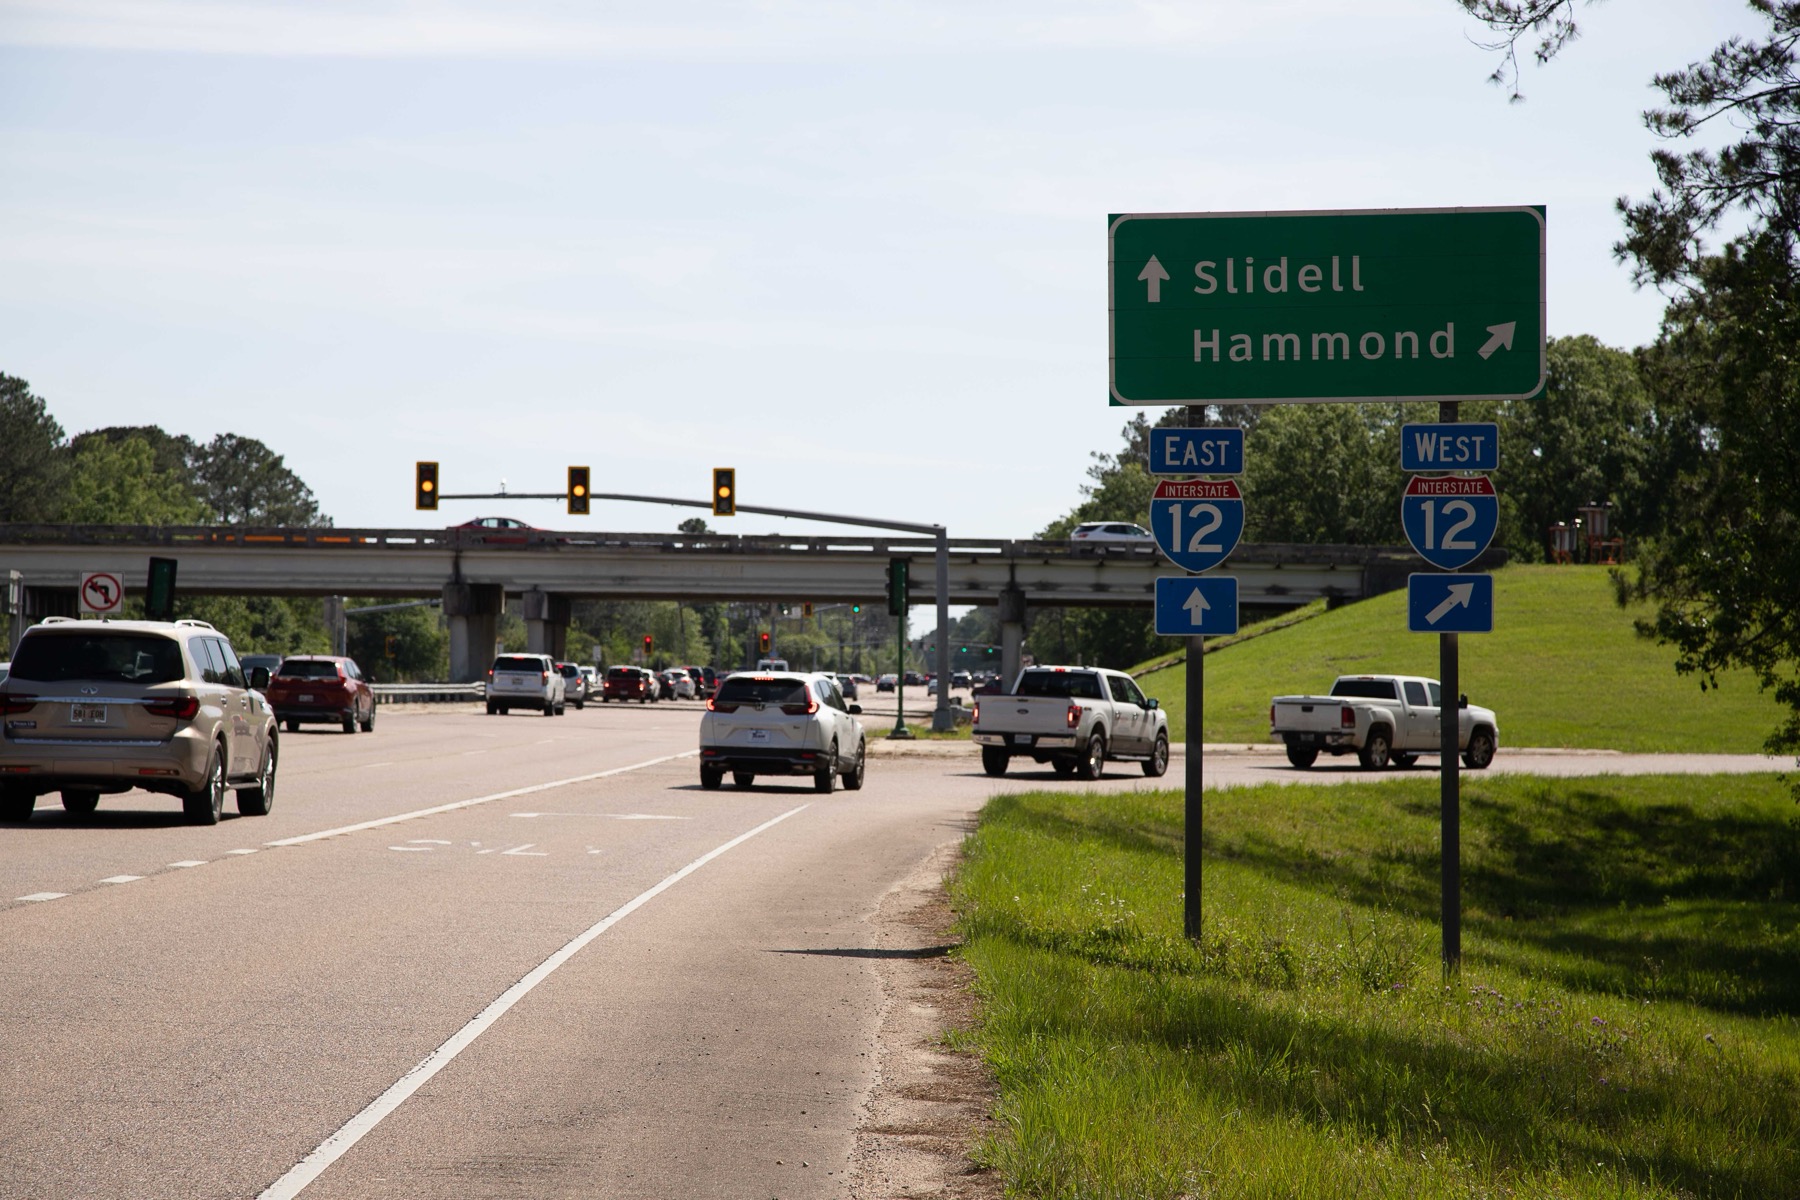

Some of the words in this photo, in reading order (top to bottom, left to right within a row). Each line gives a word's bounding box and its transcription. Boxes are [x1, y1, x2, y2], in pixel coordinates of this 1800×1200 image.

[1193, 255, 1364, 295] Slidell
[1193, 322, 1455, 362] Hammond
[1165, 436, 1230, 466] EAST
[1415, 432, 1485, 462] WEST
[1165, 485, 1229, 497] INTERSTATE
[1418, 481, 1483, 494] INTERSTATE
[1168, 503, 1223, 553] 12
[1420, 499, 1477, 550] 12
